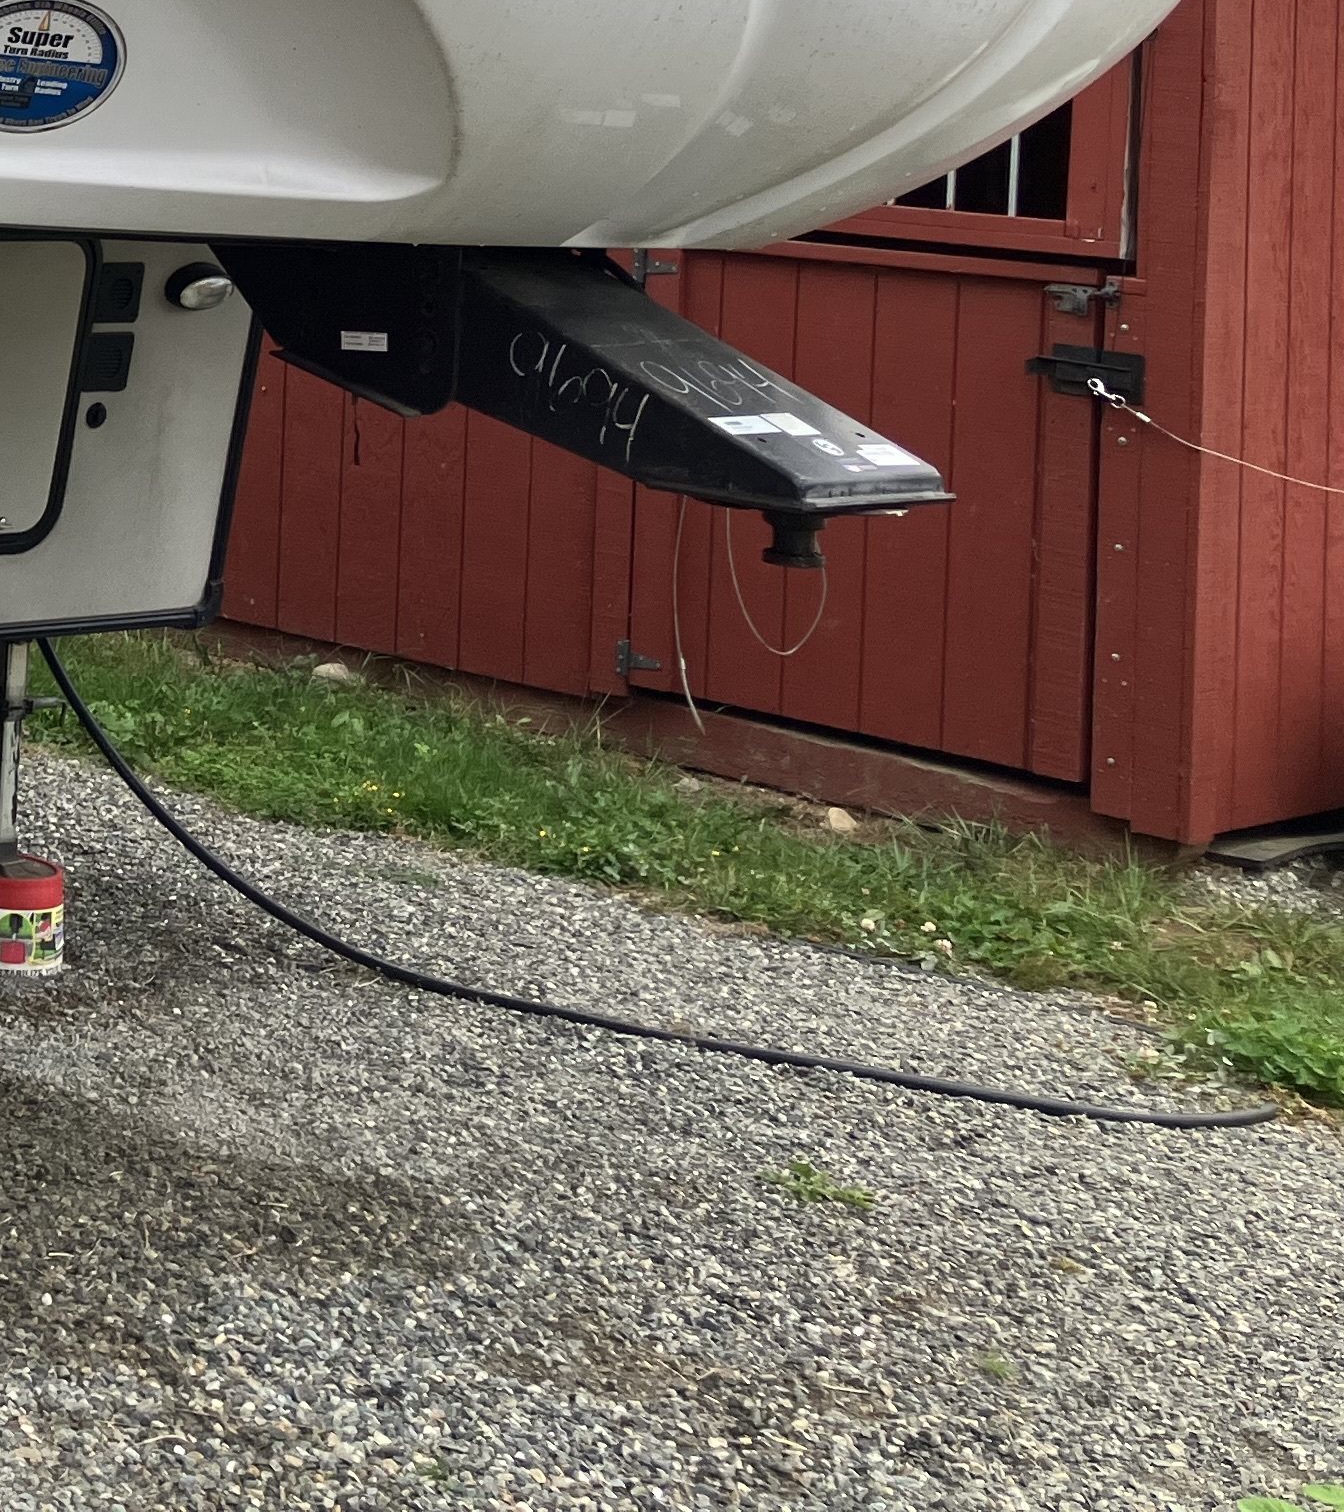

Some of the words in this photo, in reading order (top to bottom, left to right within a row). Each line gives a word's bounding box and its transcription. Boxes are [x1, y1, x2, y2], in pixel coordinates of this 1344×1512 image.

[7, 26, 74, 49] Super
[3, 44, 29, 56] Turn
[30, 47, 69, 60] Radius
